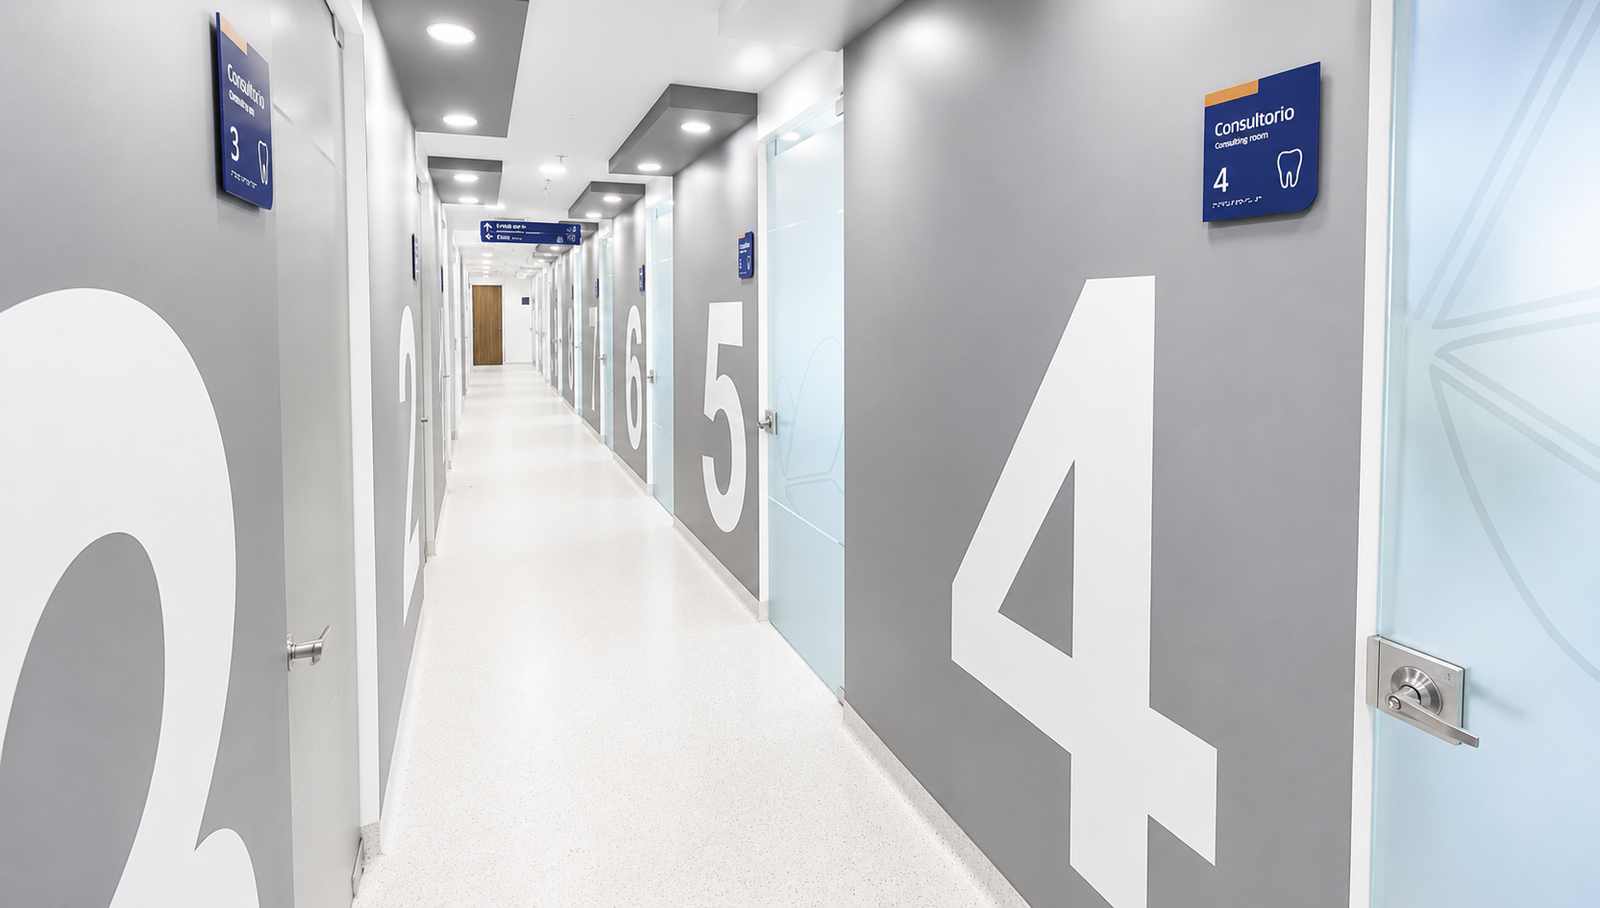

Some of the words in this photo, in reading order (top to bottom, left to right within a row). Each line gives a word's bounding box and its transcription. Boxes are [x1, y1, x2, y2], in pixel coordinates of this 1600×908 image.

[227, 63, 265, 110] Consultorio
[1214, 105, 1295, 137] Consultorio
[229, 125, 240, 162] 3
[1214, 136, 1249, 150] Consulting
[1249, 131, 1269, 142] room
[1213, 166, 1229, 193] 4
[588, 306, 598, 412] 7
[625, 304, 643, 450] 6
[702, 301, 747, 533] 5
[399, 305, 420, 627] 2
[951, 275, 1217, 908] 4
